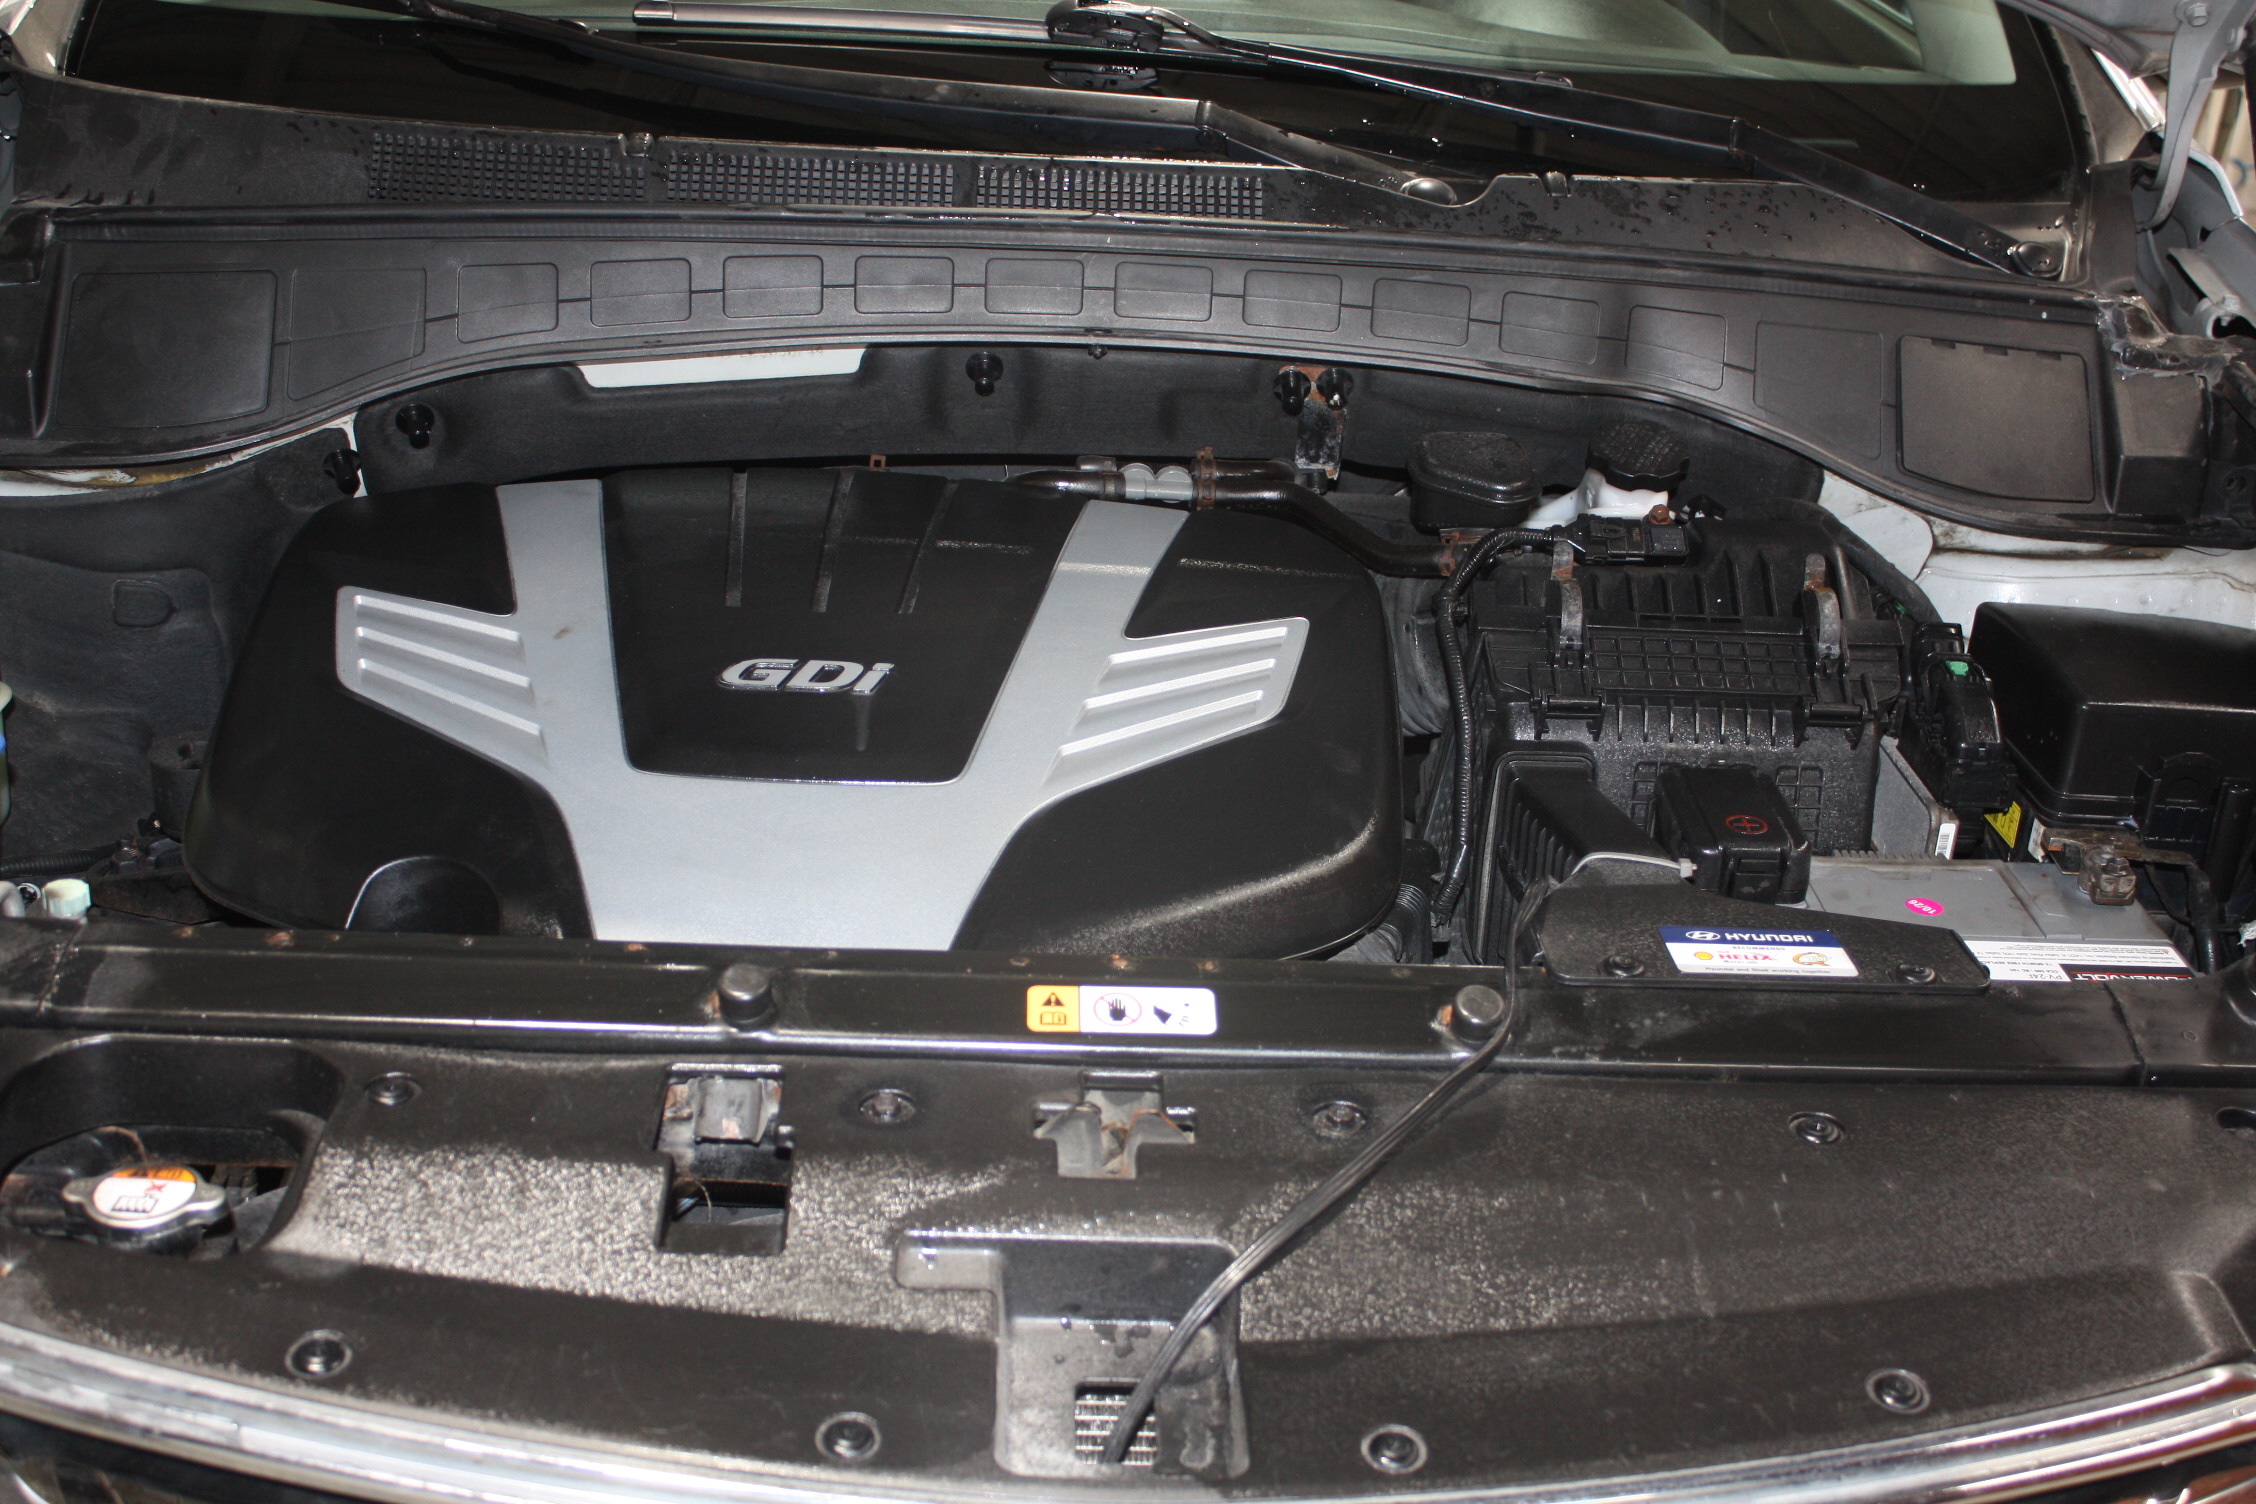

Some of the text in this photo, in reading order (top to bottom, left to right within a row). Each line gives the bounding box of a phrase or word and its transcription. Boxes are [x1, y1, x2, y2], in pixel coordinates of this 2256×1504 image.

[718, 658, 895, 695] GDi
[1724, 932, 1814, 943] HYUNDAI
[1719, 953, 1773, 961] HELIX
